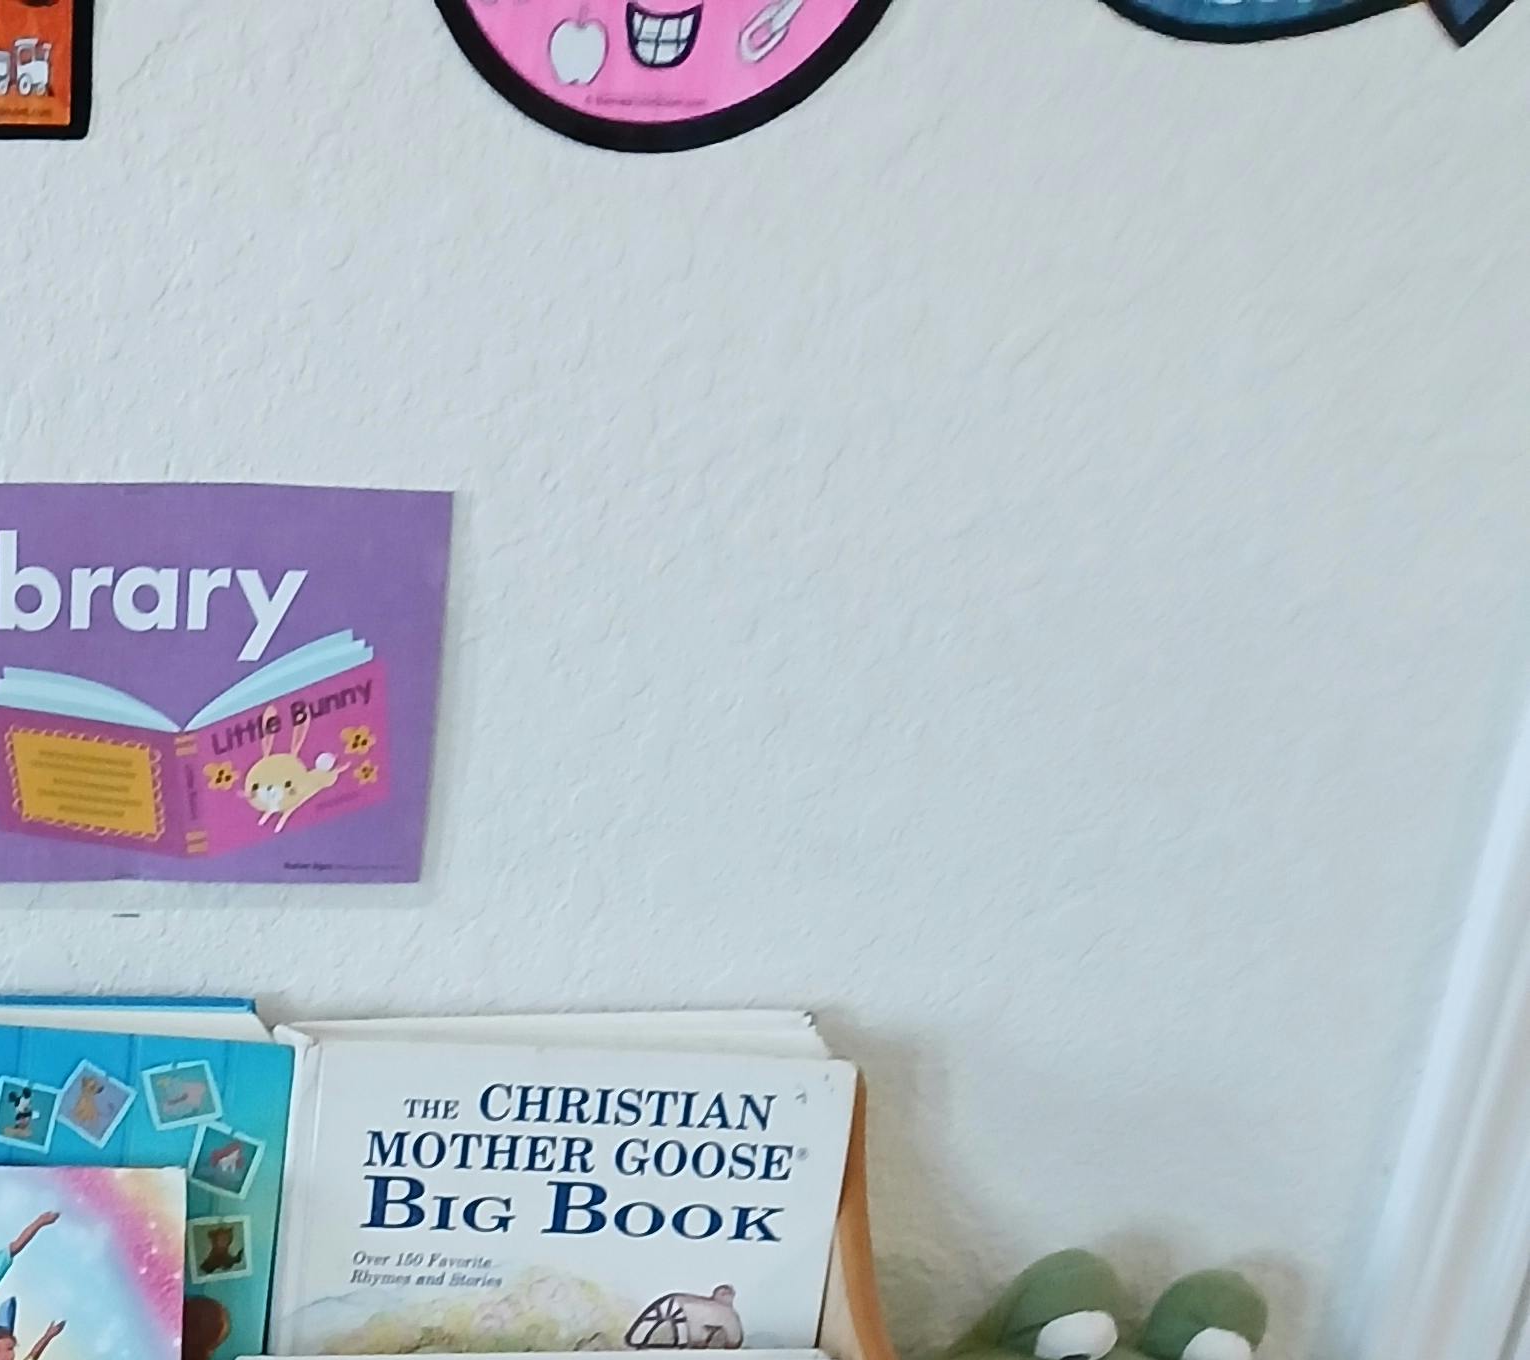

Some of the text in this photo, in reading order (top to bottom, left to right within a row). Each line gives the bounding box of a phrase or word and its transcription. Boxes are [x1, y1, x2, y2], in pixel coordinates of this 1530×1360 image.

[211, 678, 374, 757] Little Bunny
[402, 1082, 777, 1132] THE CHRISTIAN
[363, 1129, 597, 1175] MOTHER
[350, 1269, 504, 1289] Rhymes and Stories
[352, 1250, 392, 1268] Over
[427, 1253, 493, 1270] Favorite
